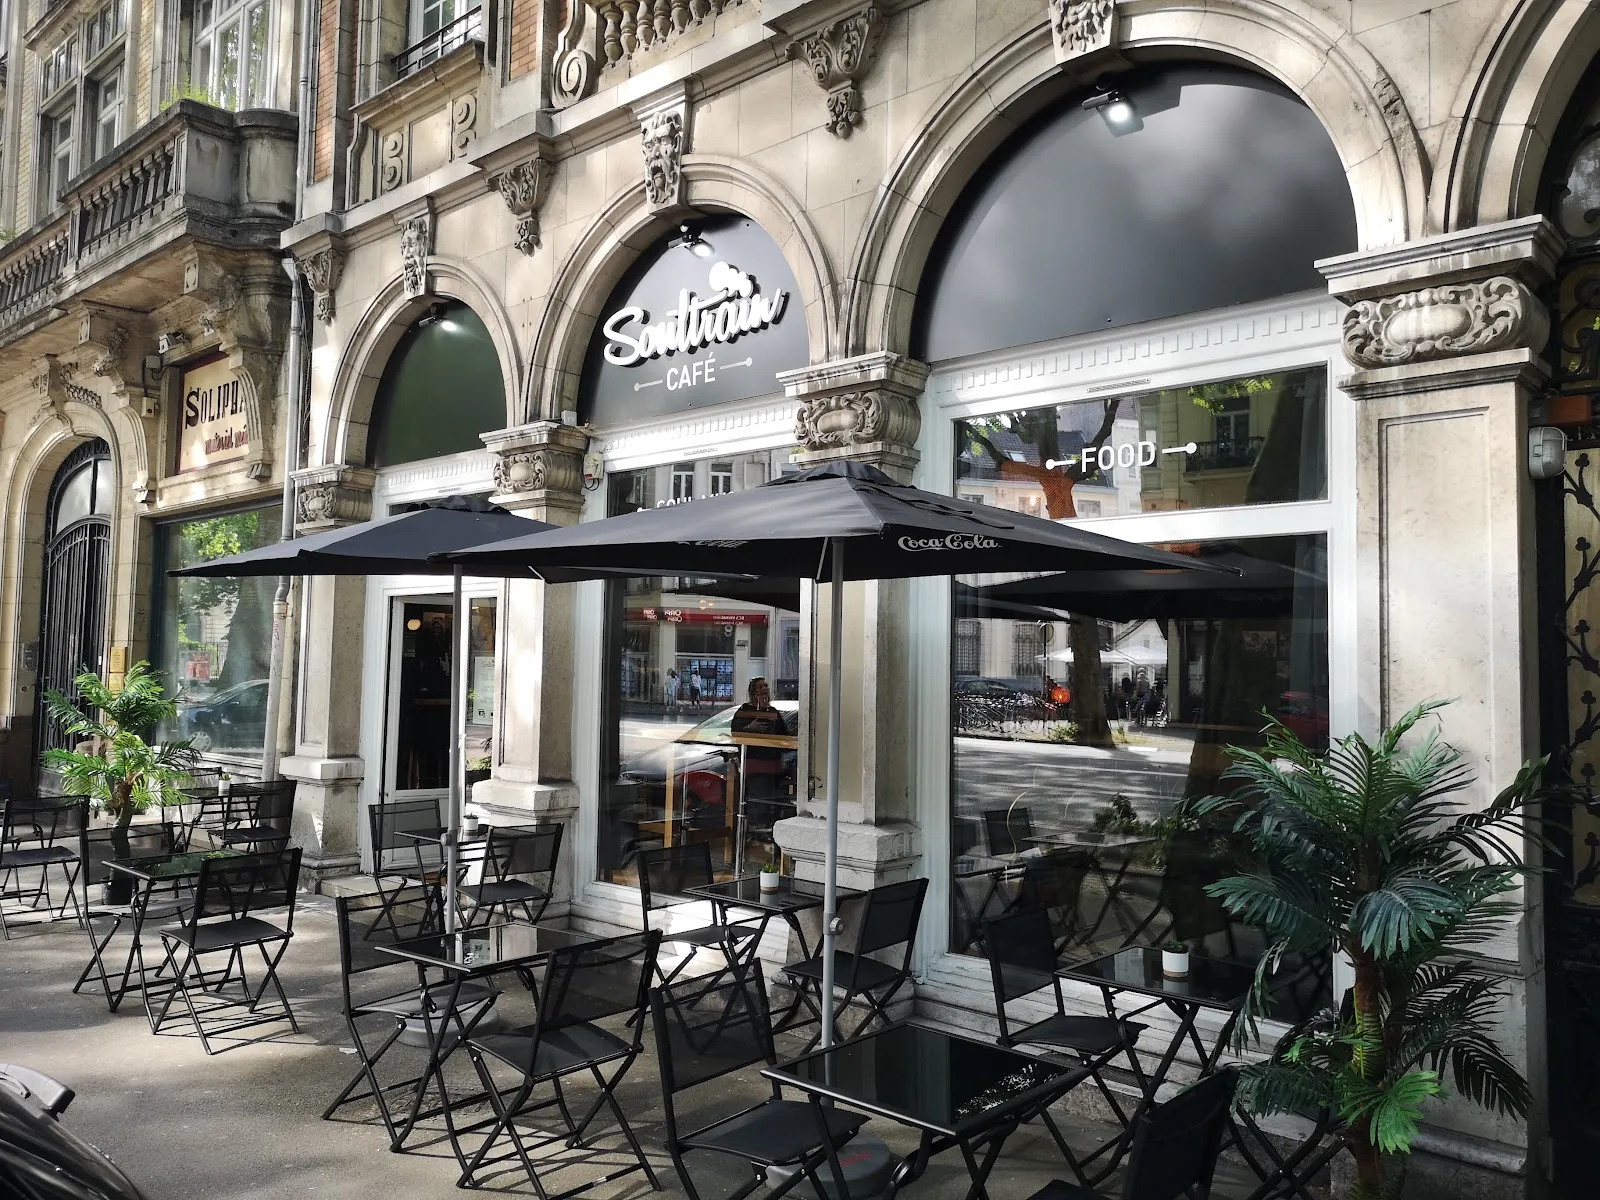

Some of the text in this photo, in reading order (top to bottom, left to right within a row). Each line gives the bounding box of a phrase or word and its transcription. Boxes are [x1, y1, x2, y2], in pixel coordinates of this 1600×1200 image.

[603, 287, 781, 366] Soultrain
[666, 352, 716, 391] CAFÉ
[1081, 441, 1156, 472] FOOD
[898, 533, 999, 551] Coca-Cola
